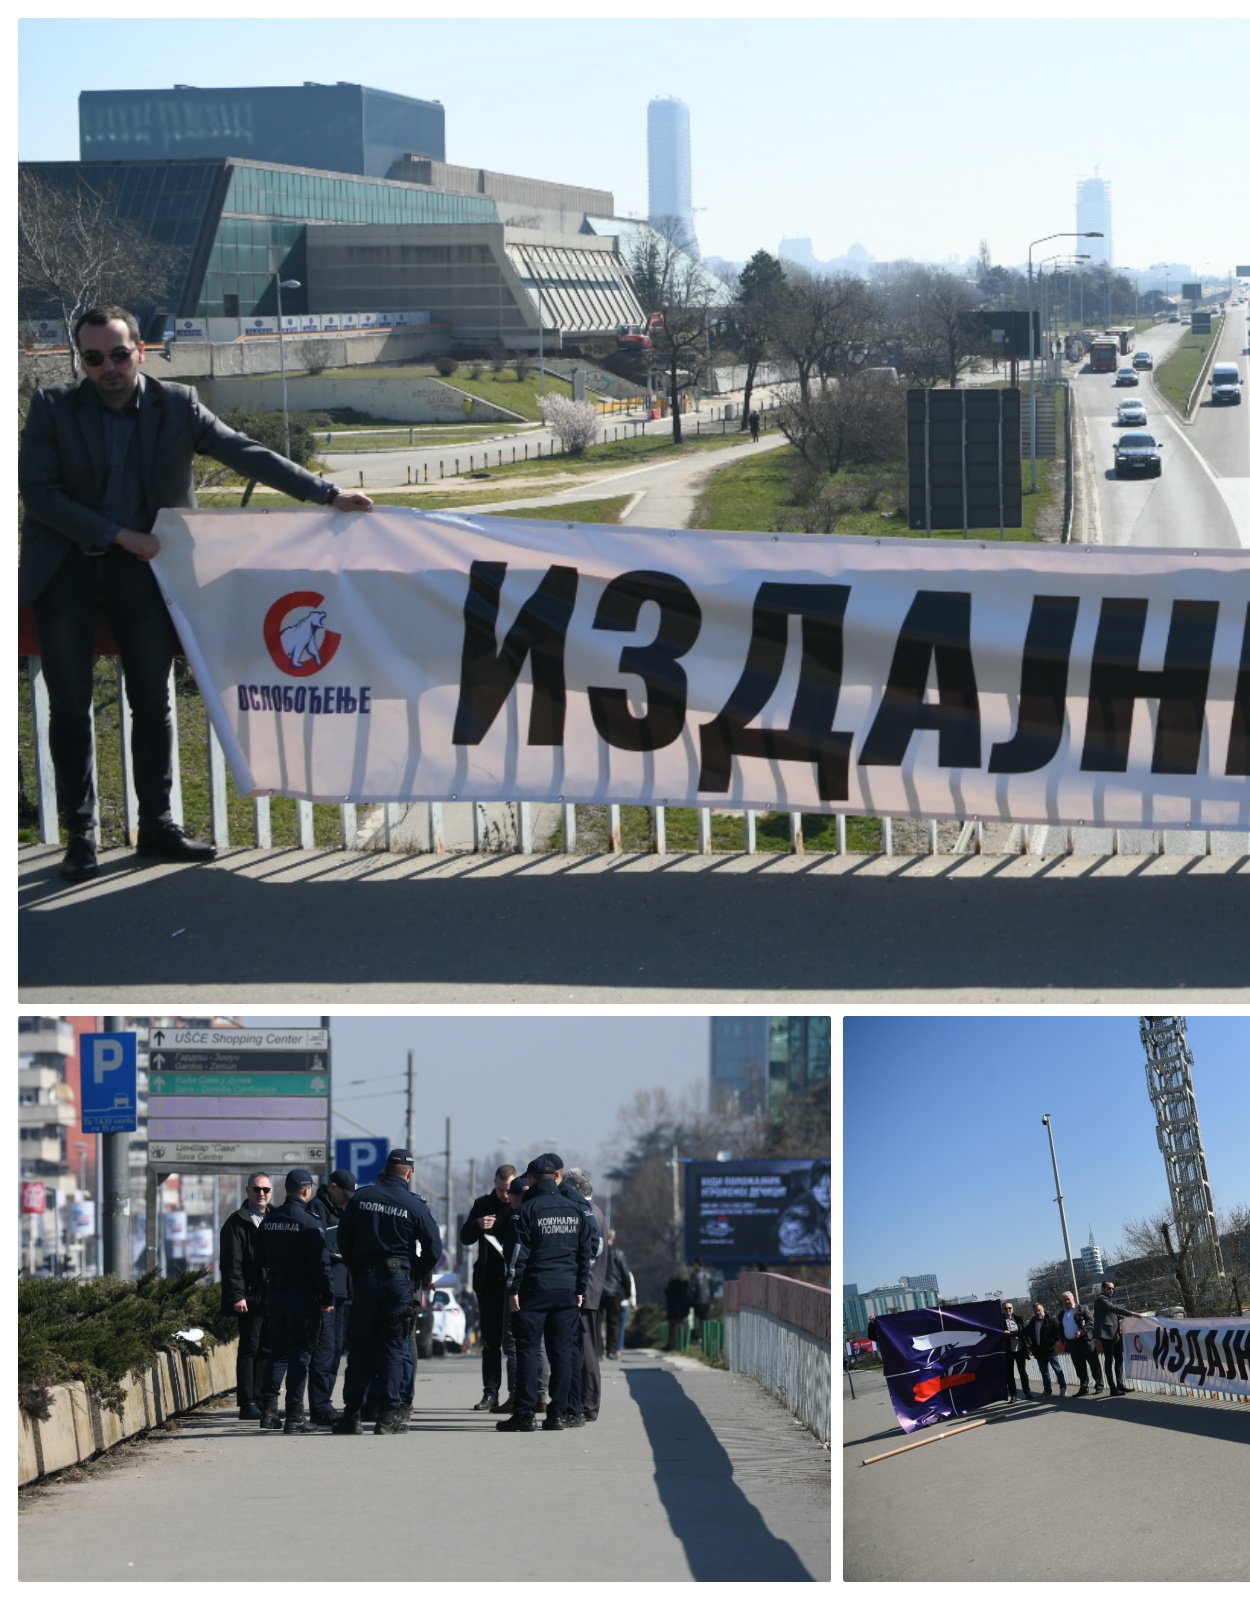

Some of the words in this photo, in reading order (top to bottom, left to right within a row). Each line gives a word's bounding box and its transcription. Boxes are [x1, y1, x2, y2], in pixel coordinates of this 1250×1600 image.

[237, 684, 371, 714] ОСЛОБОЂЕЊЕ
[175, 1031, 208, 1043] UŠĆE
[211, 1033, 263, 1046] Shopping
[266, 1033, 303, 1044] Center
[93, 1039, 124, 1084] P
[210, 1062, 237, 1070] Zemun
[175, 1153, 195, 1161] Sava
[197, 1153, 223, 1161] Centre
[309, 1149, 323, 1157] SC
[350, 1142, 377, 1183] P
[359, 1201, 408, 1219] ПОЛИЦИЈА
[263, 1222, 300, 1232] ПОЛИЦИЈА
[537, 1216, 579, 1227] КОМУНАЛНА
[541, 1225, 577, 1235] ПОЛИЦИЈА
